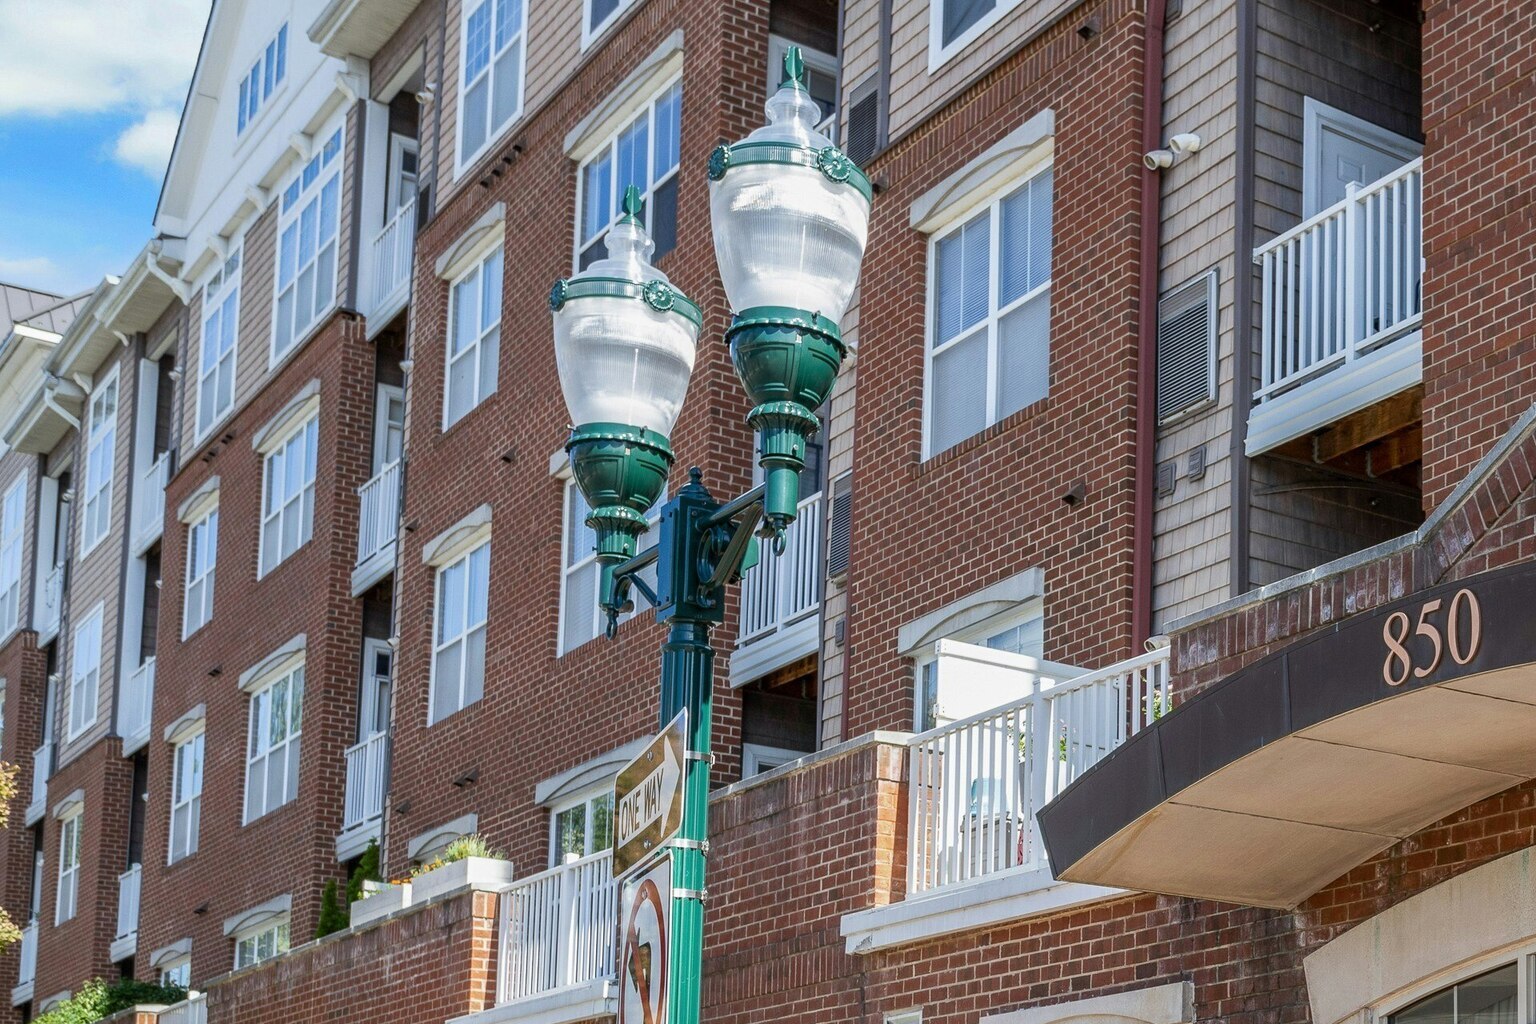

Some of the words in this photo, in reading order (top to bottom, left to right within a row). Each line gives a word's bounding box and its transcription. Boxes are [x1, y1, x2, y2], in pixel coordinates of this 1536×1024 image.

[1382, 588, 1480, 686] 850
[621, 789, 641, 840] ONE
[644, 768, 664, 823] WAY
